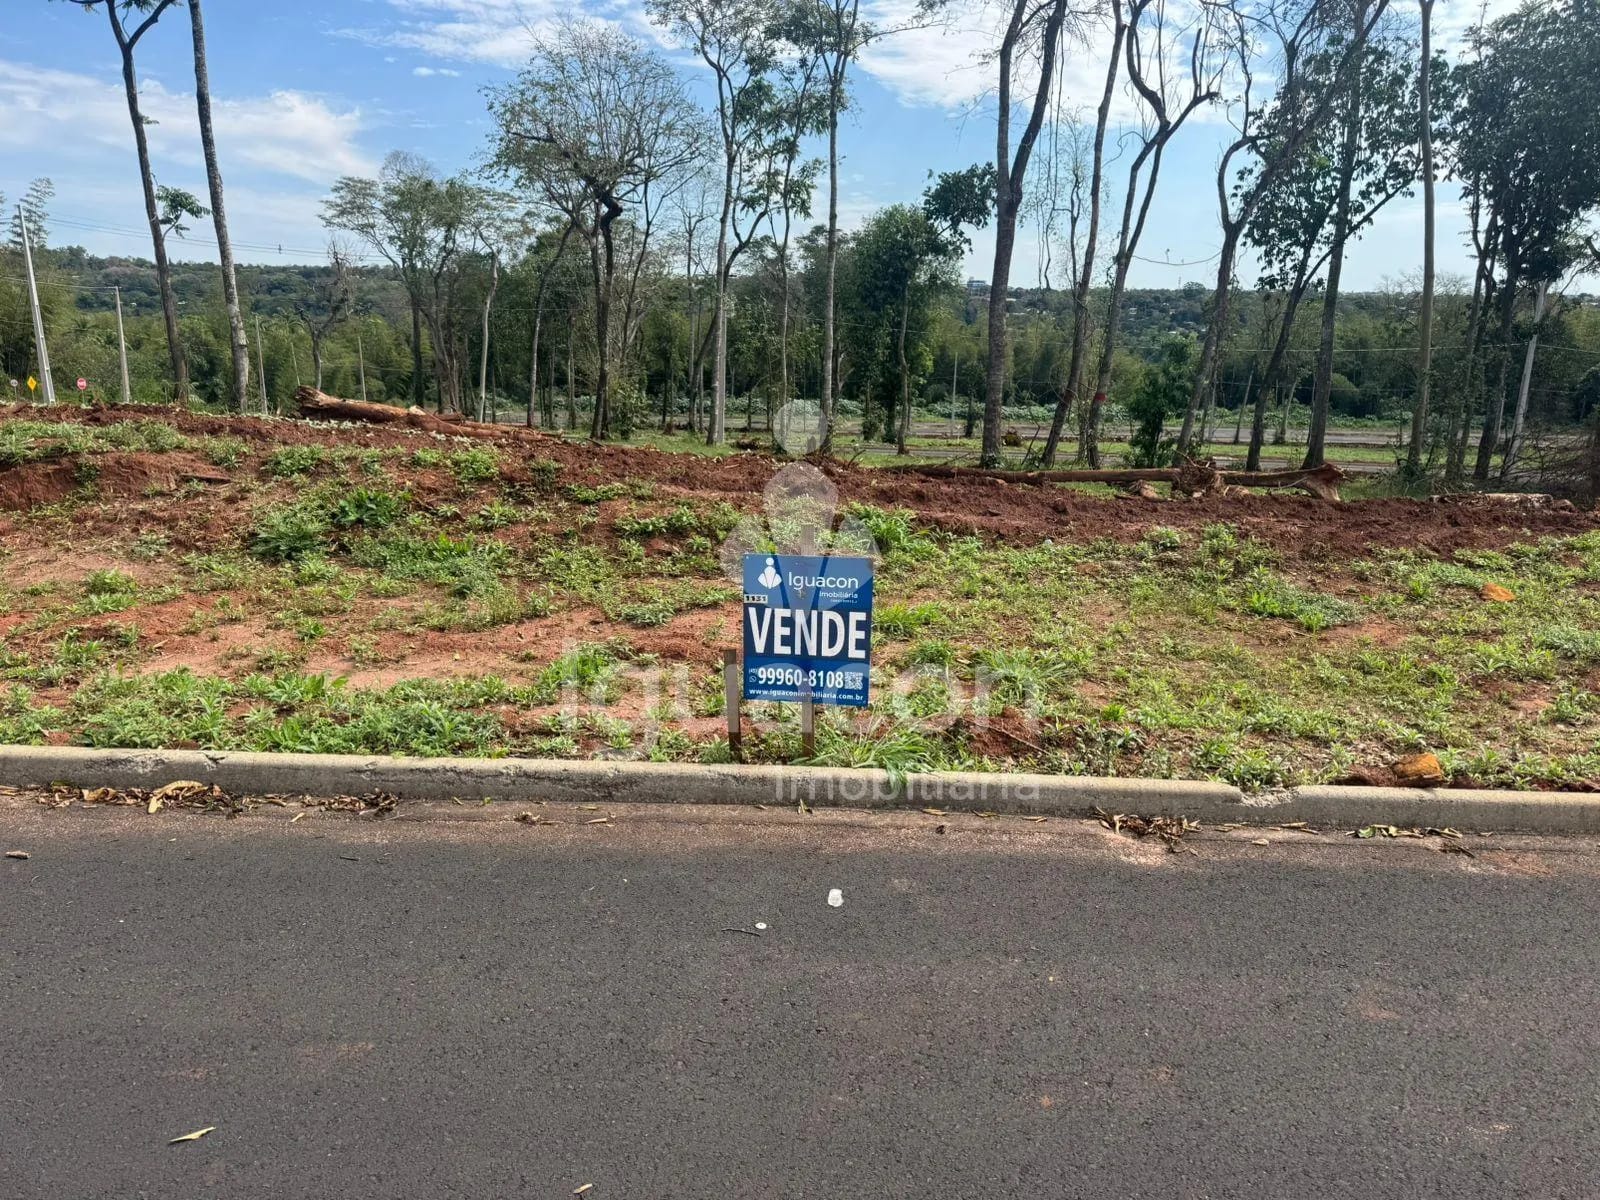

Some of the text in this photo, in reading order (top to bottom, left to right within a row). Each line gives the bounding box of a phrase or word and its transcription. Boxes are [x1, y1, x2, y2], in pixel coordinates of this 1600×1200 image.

[788, 571, 859, 590] Iguacon
[748, 607, 867, 659] VENDE
[758, 667, 844, 688] 99960-8108
